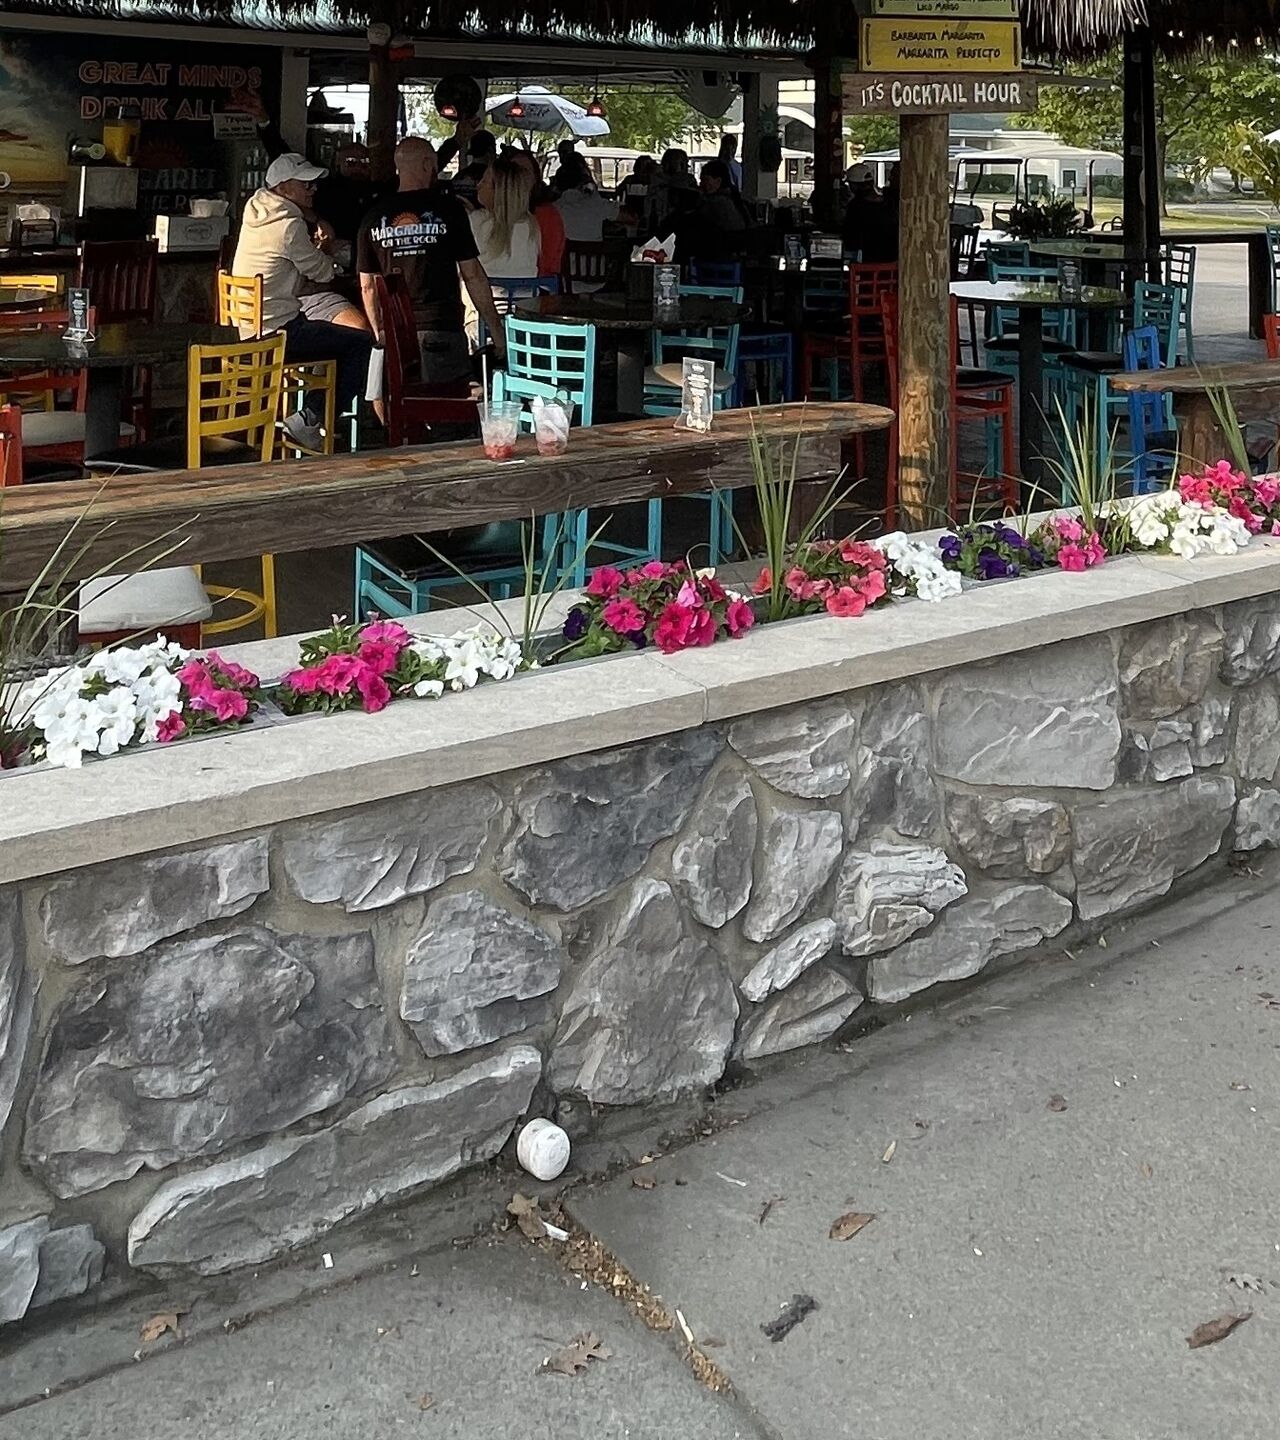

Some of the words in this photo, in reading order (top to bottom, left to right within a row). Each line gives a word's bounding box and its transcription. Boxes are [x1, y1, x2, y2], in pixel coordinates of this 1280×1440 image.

[891, 30, 937, 41] BARBARITA
[940, 30, 985, 41] MARGARITA
[897, 47, 948, 59] MARGARITA
[956, 47, 1000, 59] PERFECTO
[78, 61, 171, 86] GREAT
[178, 63, 262, 89] MINDS
[862, 79, 885, 107] IT'S
[891, 80, 967, 107] COCKTAIL
[974, 82, 1021, 104] HOUR
[371, 223, 448, 242] MARGARITAS
